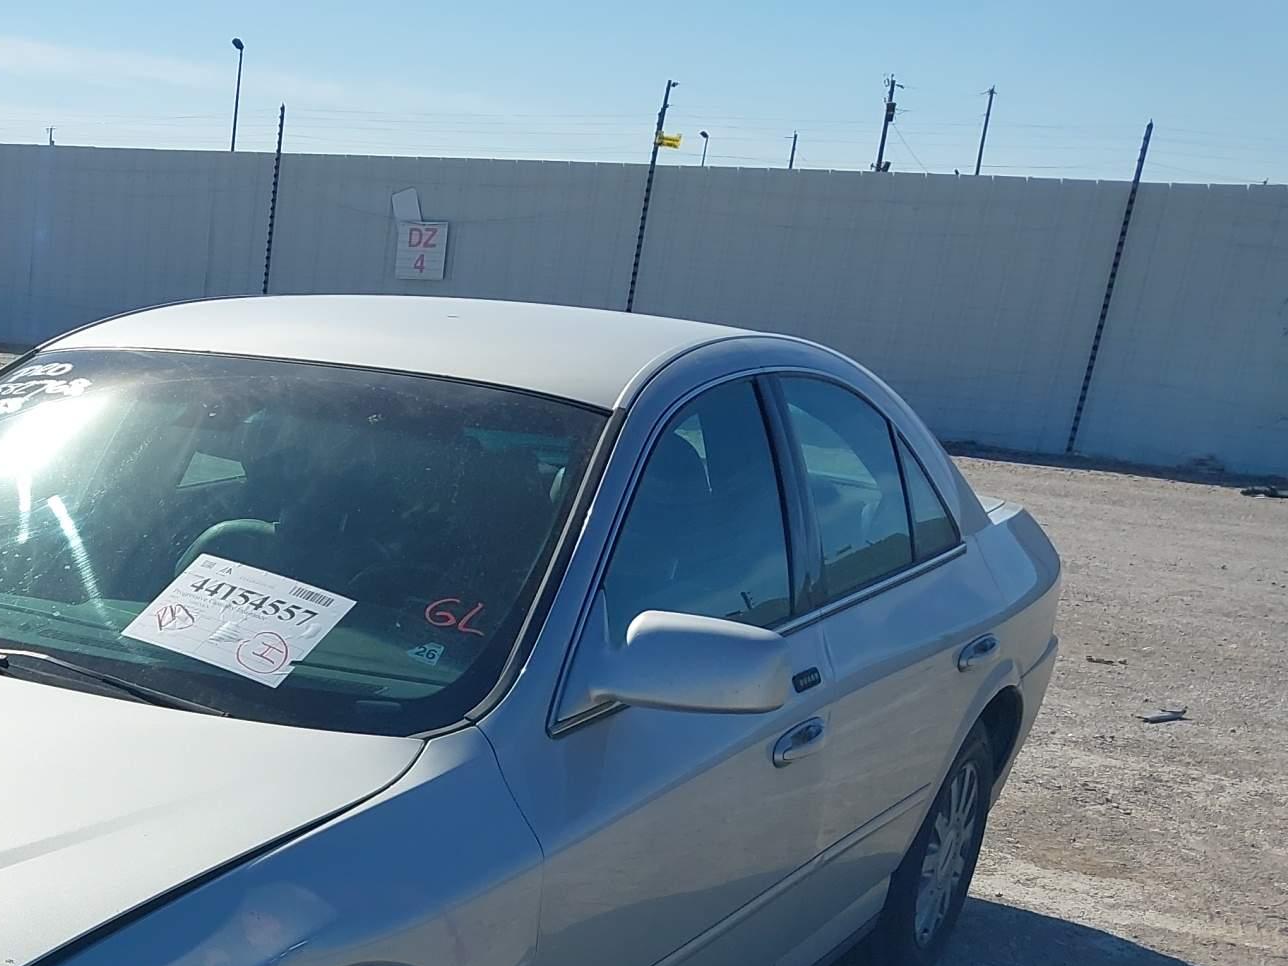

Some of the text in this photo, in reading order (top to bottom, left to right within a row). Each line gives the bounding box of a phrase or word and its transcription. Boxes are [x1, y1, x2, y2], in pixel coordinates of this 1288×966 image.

[408, 227, 438, 248] DZ
[414, 254, 425, 273] 4
[190, 577, 319, 626] 44154557
[414, 646, 438, 660] 26
